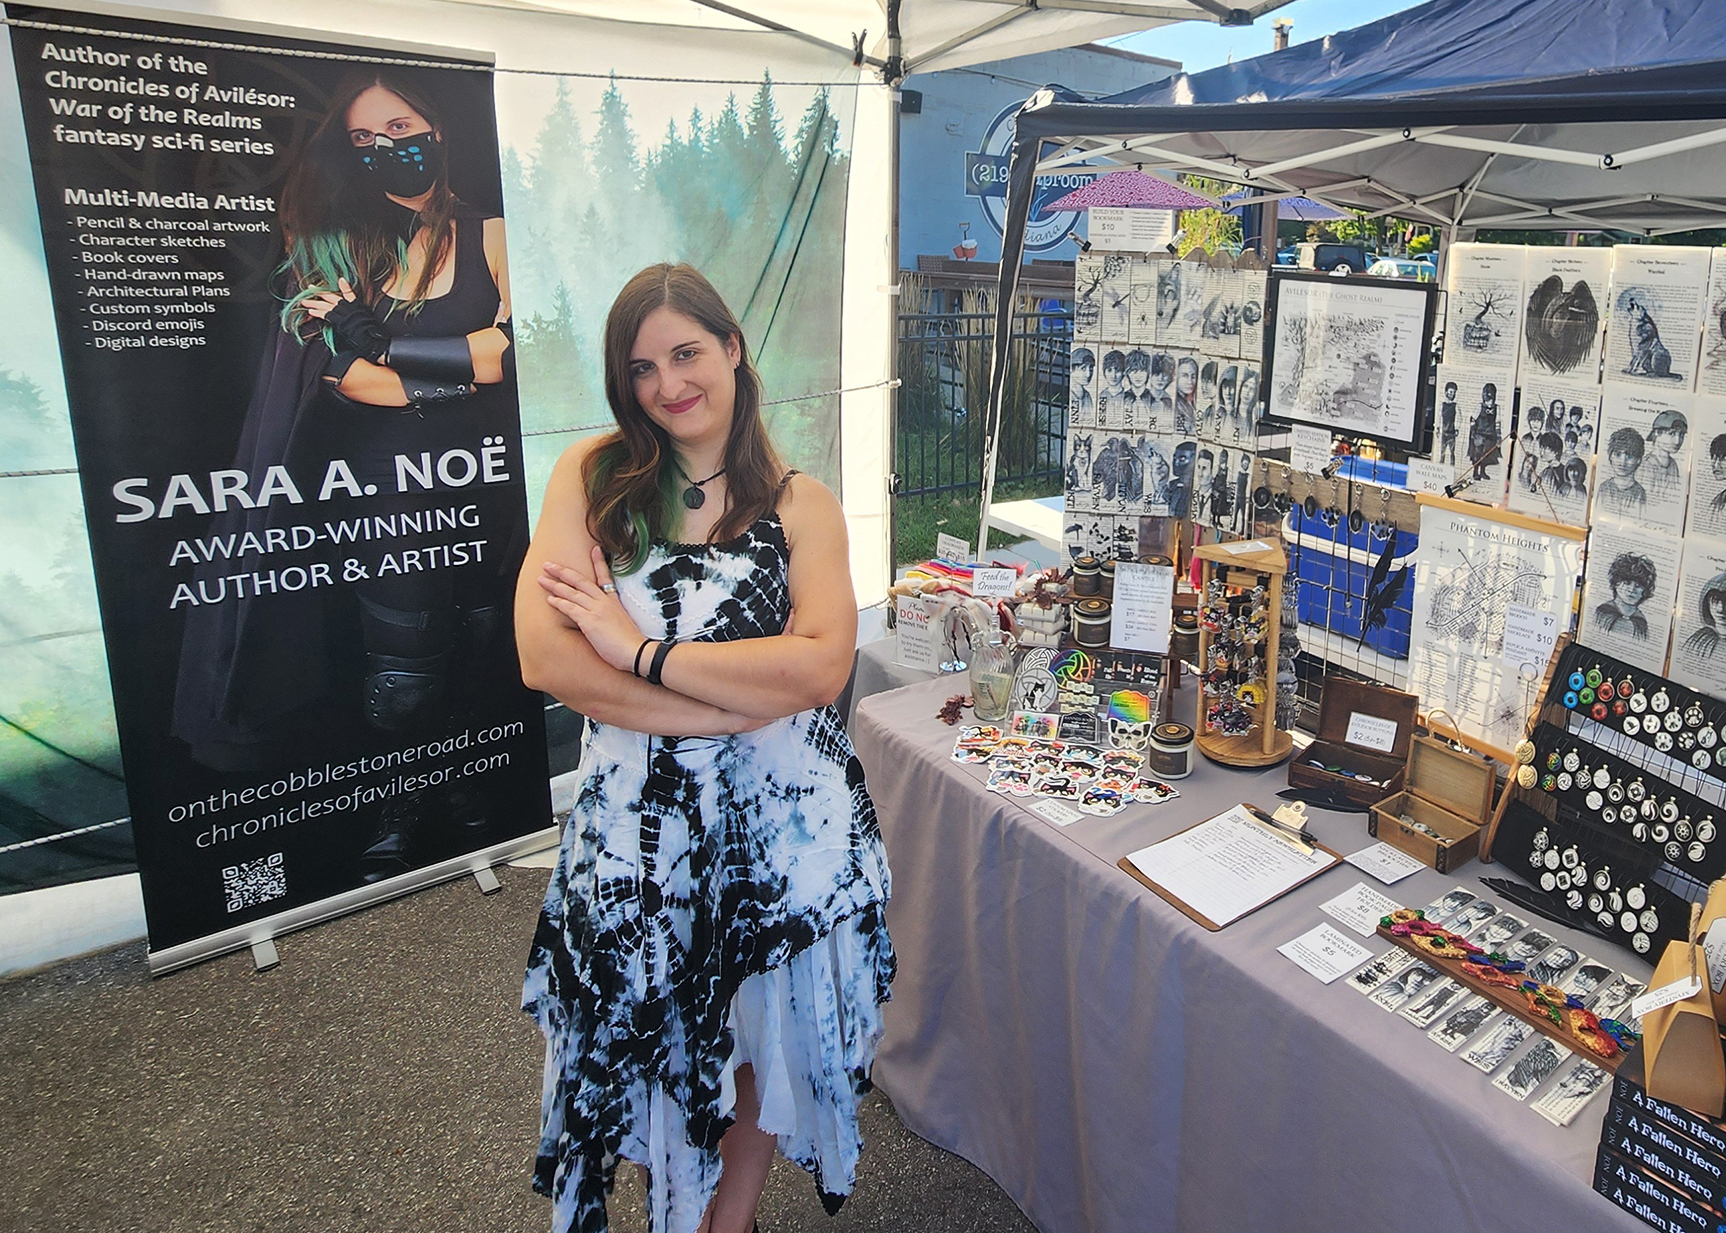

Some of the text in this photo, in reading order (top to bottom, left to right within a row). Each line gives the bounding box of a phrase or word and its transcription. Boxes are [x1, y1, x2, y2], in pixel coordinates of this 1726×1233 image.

[41, 43, 208, 75] Author of the
[44, 70, 296, 108] Chronicles of Avilésor:
[49, 98, 262, 130] War of the Realms
[53, 124, 275, 155] fantasy sci-fi series
[64, 188, 276, 212] Multi-Media Artist
[77, 216, 270, 233] Pencil & charcoal artwork
[1101, 223, 1115, 231] $10
[79, 234, 226, 248] Character sketches
[82, 251, 179, 264] Book covers
[84, 268, 225, 283] Hand-drawn maps
[87, 286, 231, 297] Architectural Plans
[1335, 291, 1358, 300] GHOST
[1360, 295, 1383, 303] REALM)
[89, 302, 216, 316] Custom symbols
[92, 318, 205, 332] Discord emojis
[95, 336, 206, 351] Digital designs
[1070, 400, 1080, 425] FINN
[1124, 408, 1133, 427] JAY
[1149, 416, 1157, 430] RC
[1298, 434, 1326, 443] KEYCHAINS
[1306, 461, 1314, 469] $5
[1416, 469, 1430, 477] WALL
[1421, 463, 1443, 472] CANVAS
[111, 435, 510, 523] SARA A. NOË
[1424, 481, 1437, 491] $40
[1067, 491, 1075, 508] KIT
[1144, 493, 1152, 513] WES
[169, 504, 480, 566] AWARD-WINNING
[1450, 522, 1549, 552] PHANTOM HEIGHTS
[169, 540, 488, 609] AUTHOR & ARTIST
[981, 570, 1009, 581] Feed the
[978, 582, 1012, 591] Dragons!
[900, 609, 928, 624] DO NO
[1509, 607, 1536, 617] HANDMADE
[1509, 612, 1554, 626] BROOCH $7
[898, 620, 915, 628] REMOVE
[1508, 624, 1534, 634] HANDMADE
[1507, 629, 1553, 645] NECKLACE $10
[1506, 642, 1524, 651] REPLICA
[1505, 647, 1527, 656] PENDANT
[1534, 656, 1549, 667] $15
[1353, 731, 1363, 740] $2
[167, 719, 524, 824] onthecobblestoneroad.com
[194, 750, 511, 849] chroniclesofavilesor.com
[1244, 820, 1318, 865] MONTHLY NEWSLETTER
[1356, 897, 1384, 914] HOLDER
[1357, 891, 1393, 913] BOOK PAGE
[1361, 886, 1400, 909] HANDMADE
[1357, 905, 1370, 914] $8
[1320, 933, 1357, 958] BOOKMARK
[1322, 946, 1337, 956] $5
[1325, 929, 1362, 956] LAMINATED
[1712, 970, 1723, 987] BOX
[1636, 990, 1690, 1015] MYSTERY BOX
[1467, 1054, 1491, 1069] WES
[1495, 1079, 1526, 1099] RAYVEN
[1632, 1091, 1726, 1153] A Fallen Hero
[1628, 1116, 1721, 1179] A Fallen Hero
[1621, 1137, 1713, 1202] A Fallen Hero
[1616, 1164, 1707, 1230] A Fallen Hero
[1613, 1187, 1688, 1233] A Fallen He
